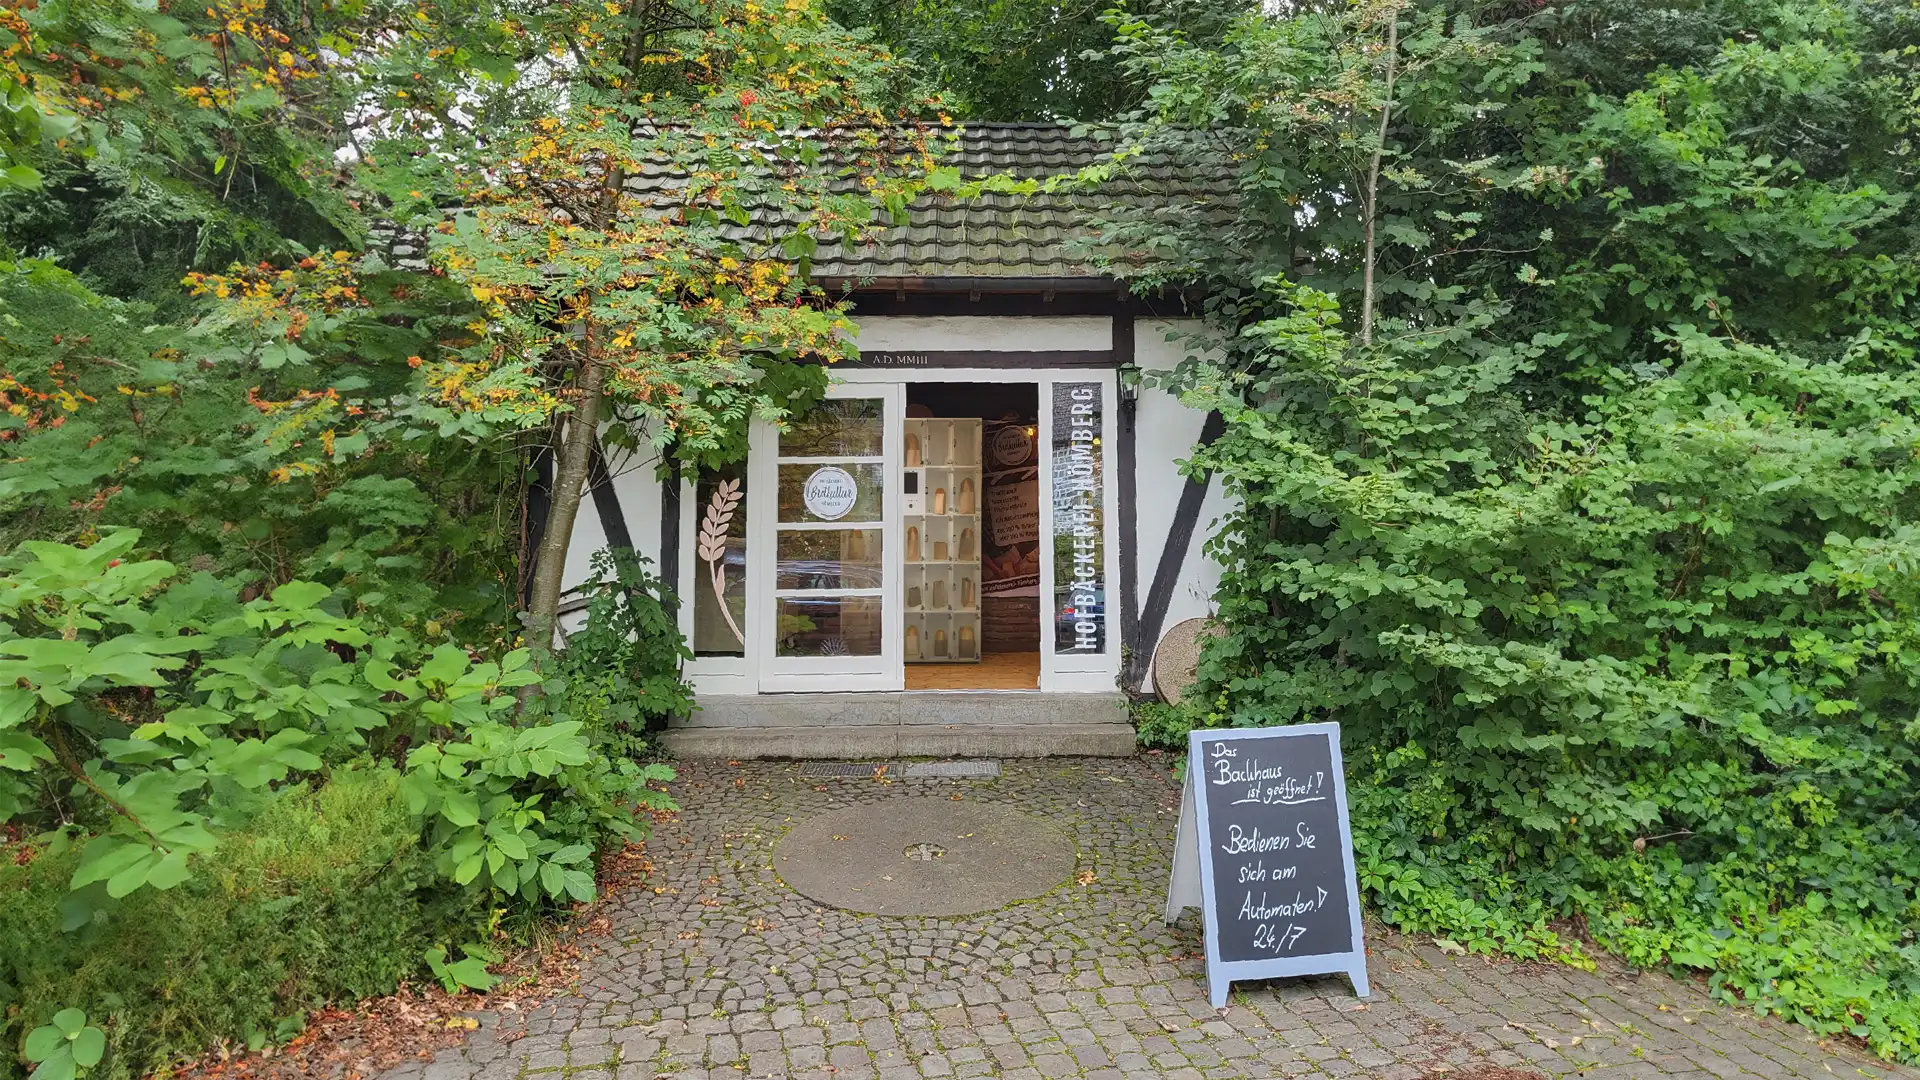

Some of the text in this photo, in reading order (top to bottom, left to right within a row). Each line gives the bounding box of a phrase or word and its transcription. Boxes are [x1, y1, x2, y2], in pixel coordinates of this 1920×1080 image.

[896, 355, 928, 365] MMIII
[1070, 504, 1097, 649] HOFBÄCKEREI
[1211, 742, 1237, 758] Das
[1213, 759, 1282, 785] Backhaus
[1247, 782, 1261, 799] ist
[1222, 822, 1316, 854] Bedienen Sie
[1238, 860, 1296, 884] sich am
